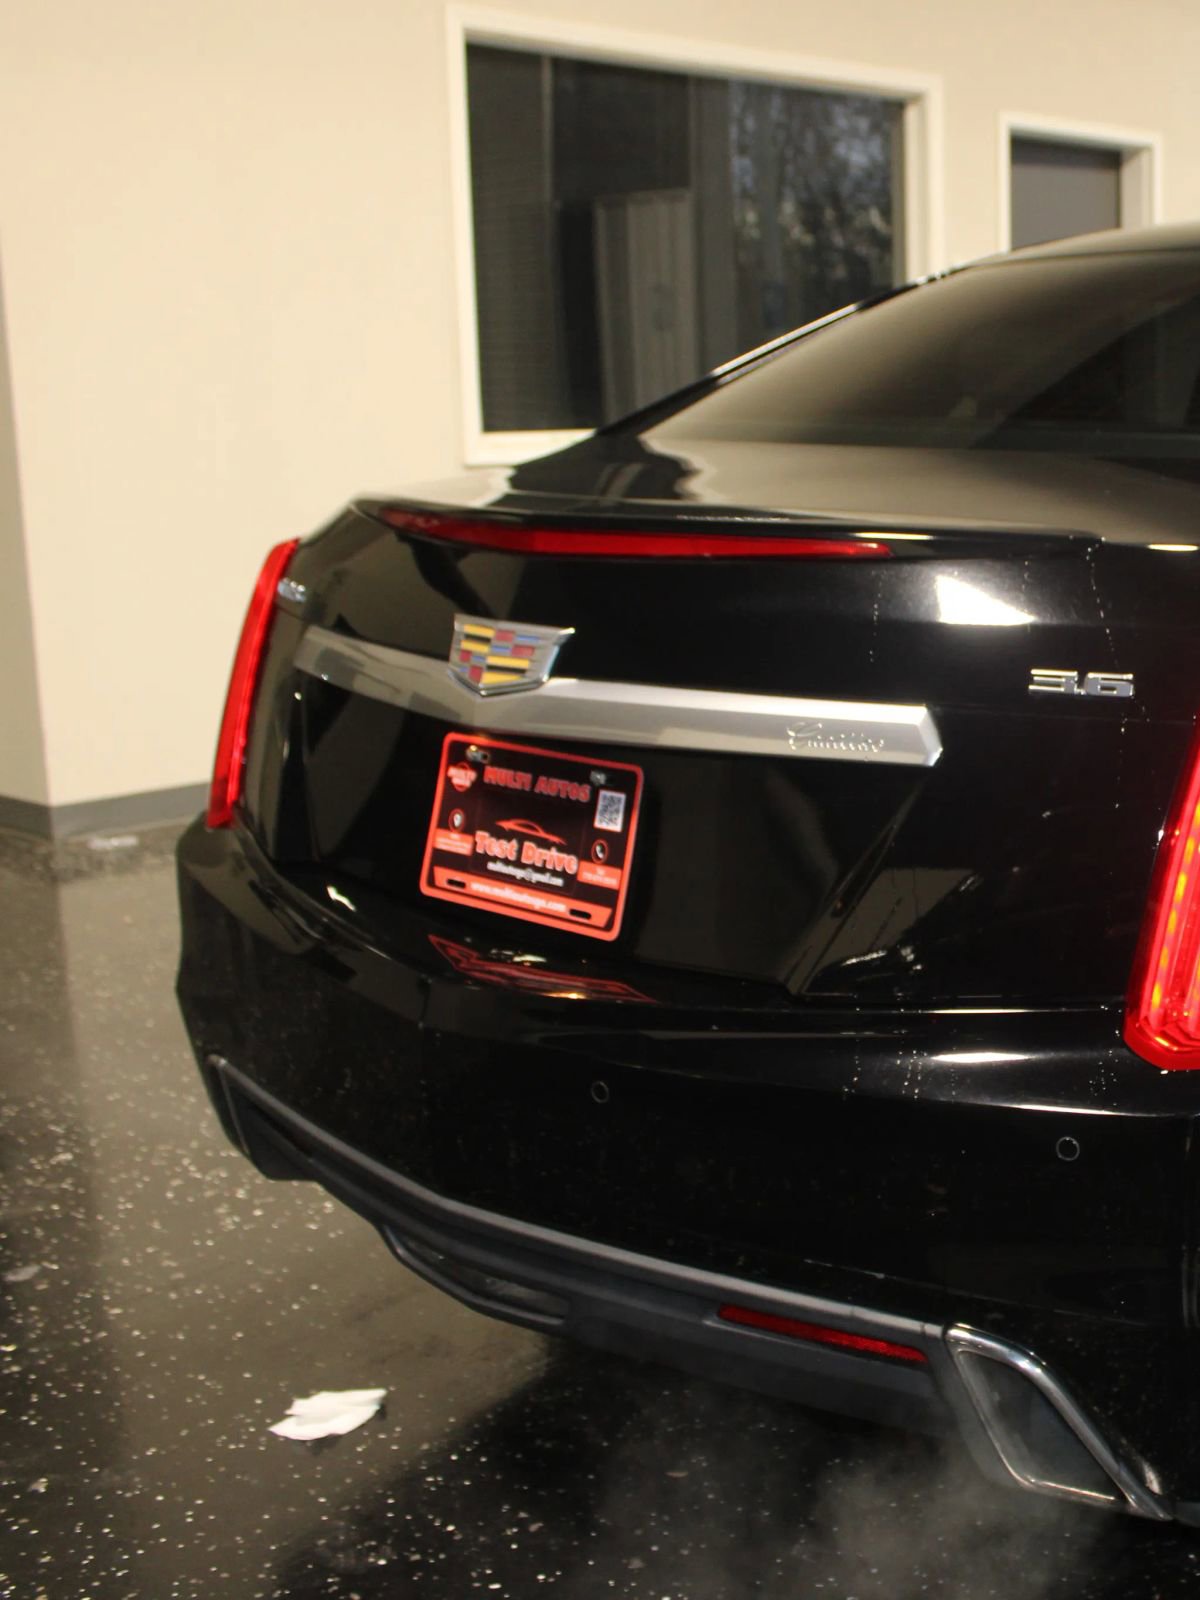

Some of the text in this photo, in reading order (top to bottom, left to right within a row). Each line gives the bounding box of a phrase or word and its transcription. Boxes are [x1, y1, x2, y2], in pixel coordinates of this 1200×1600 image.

[1028, 668, 1134, 697] 3.6
[534, 776, 591, 802] AUTOS
[474, 830, 519, 861] Test
[520, 841, 578, 875] Drive
